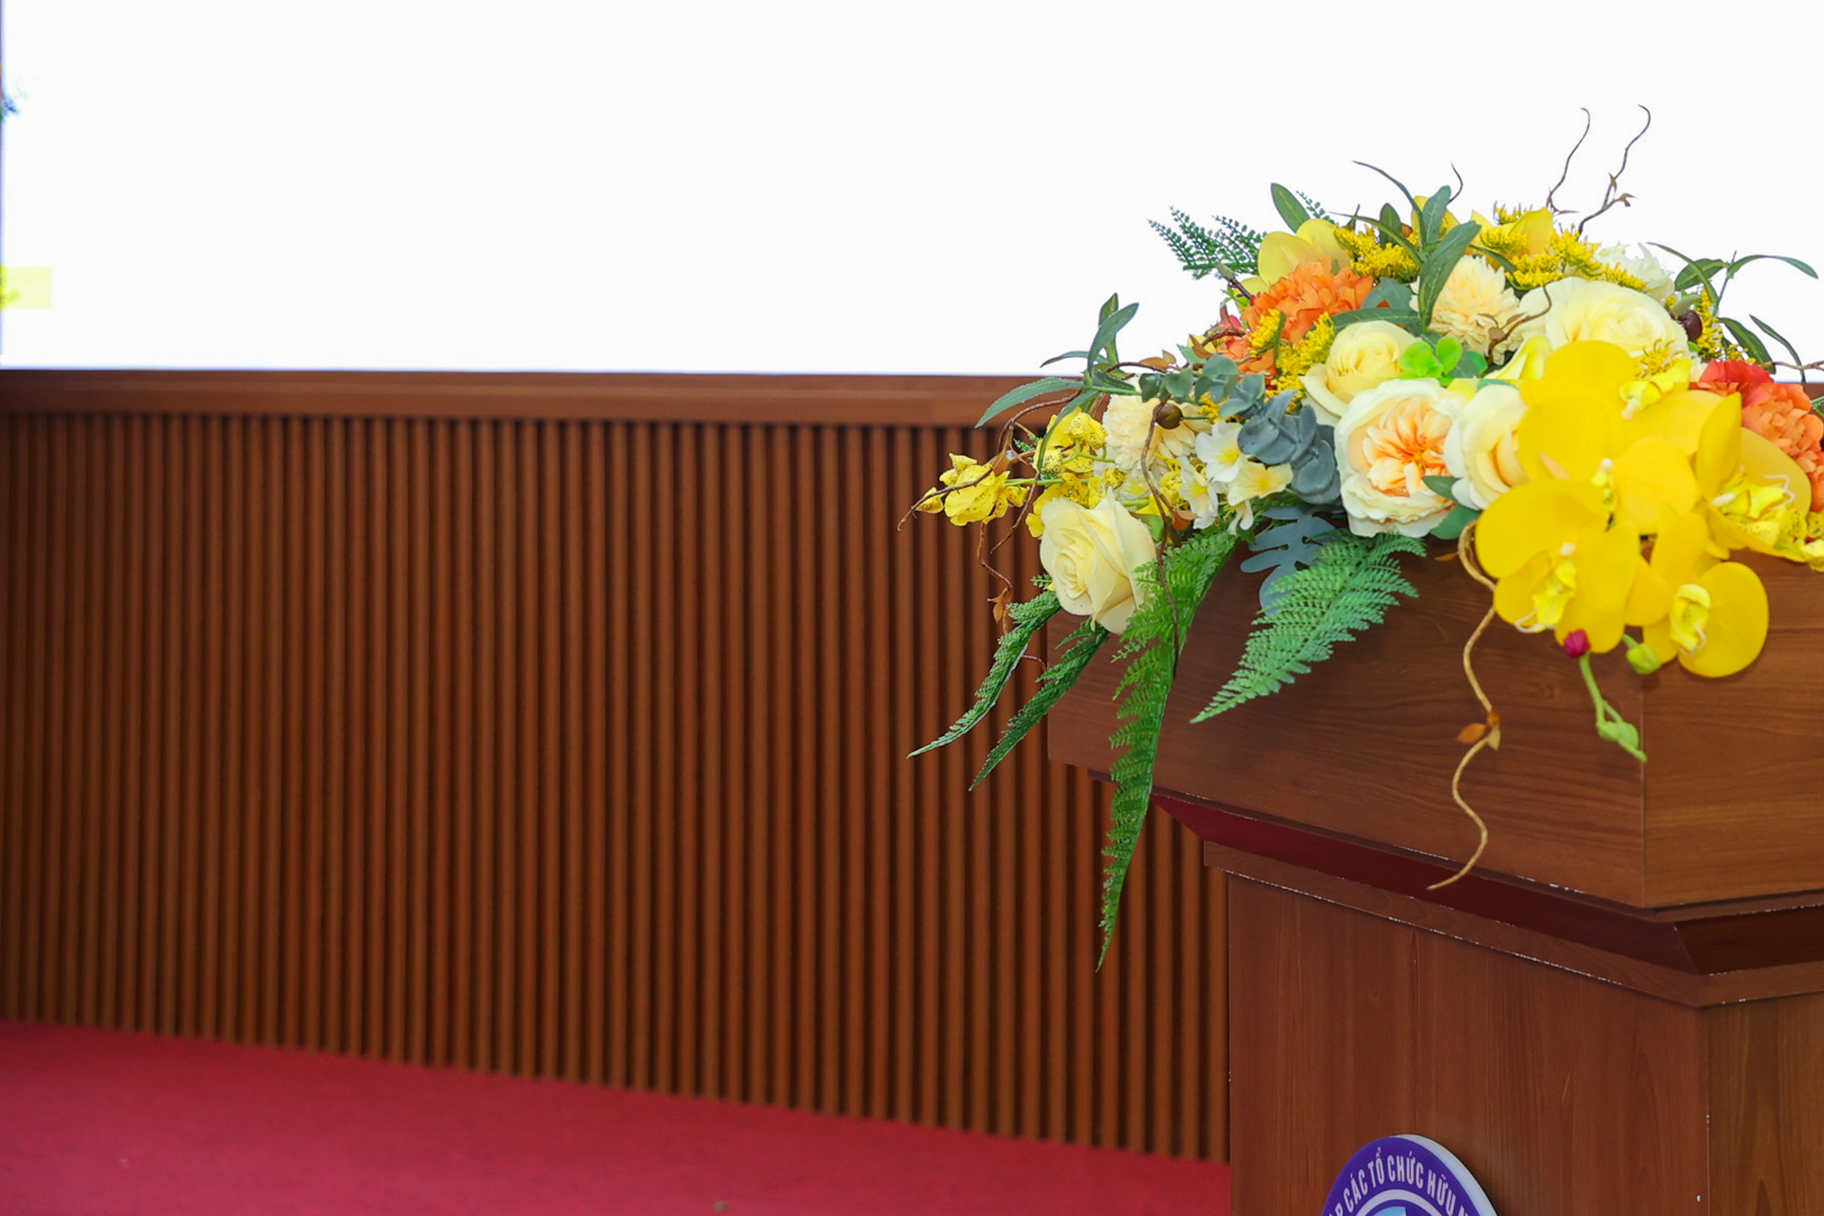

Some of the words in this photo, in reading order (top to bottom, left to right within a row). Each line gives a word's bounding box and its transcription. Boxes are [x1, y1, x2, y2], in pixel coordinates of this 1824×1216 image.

[1343, 1170, 1368, 1214] CÁC
[1367, 1147, 1385, 1188] TỔ
[1387, 1151, 1424, 1189] CHỨC
[1427, 1170, 1456, 1216] HỮU
